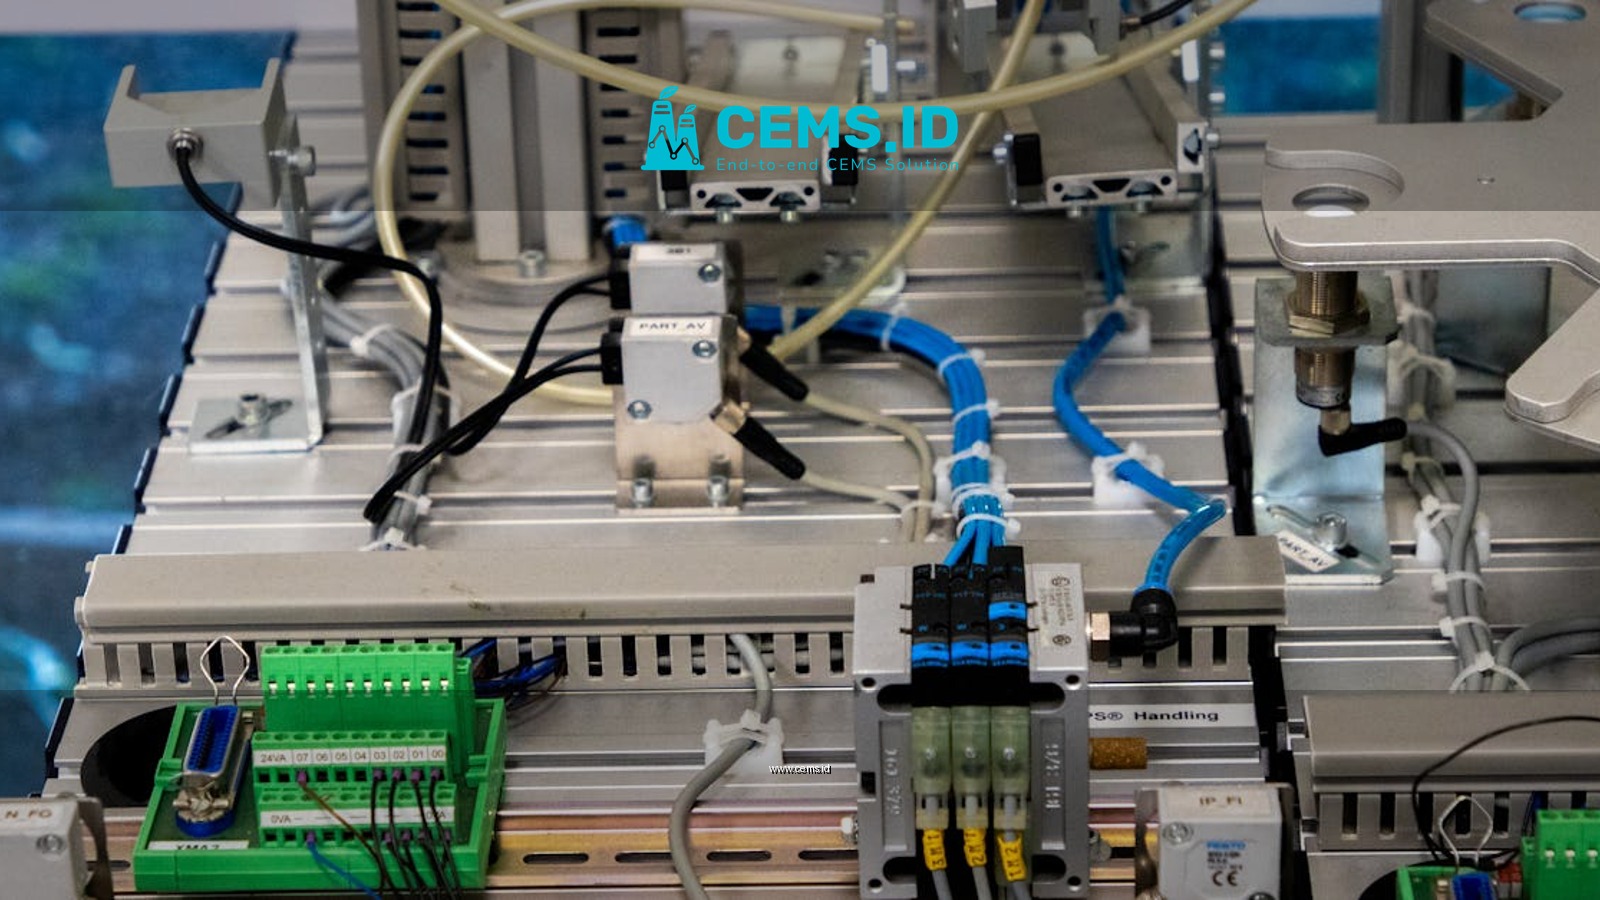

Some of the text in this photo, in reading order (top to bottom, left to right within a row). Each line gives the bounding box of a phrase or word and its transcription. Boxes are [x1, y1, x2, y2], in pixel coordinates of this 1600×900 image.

[1134, 711, 1218, 722] Handling
[260, 749, 444, 763] 24VA 07 06 05 04 03 02 01 00
